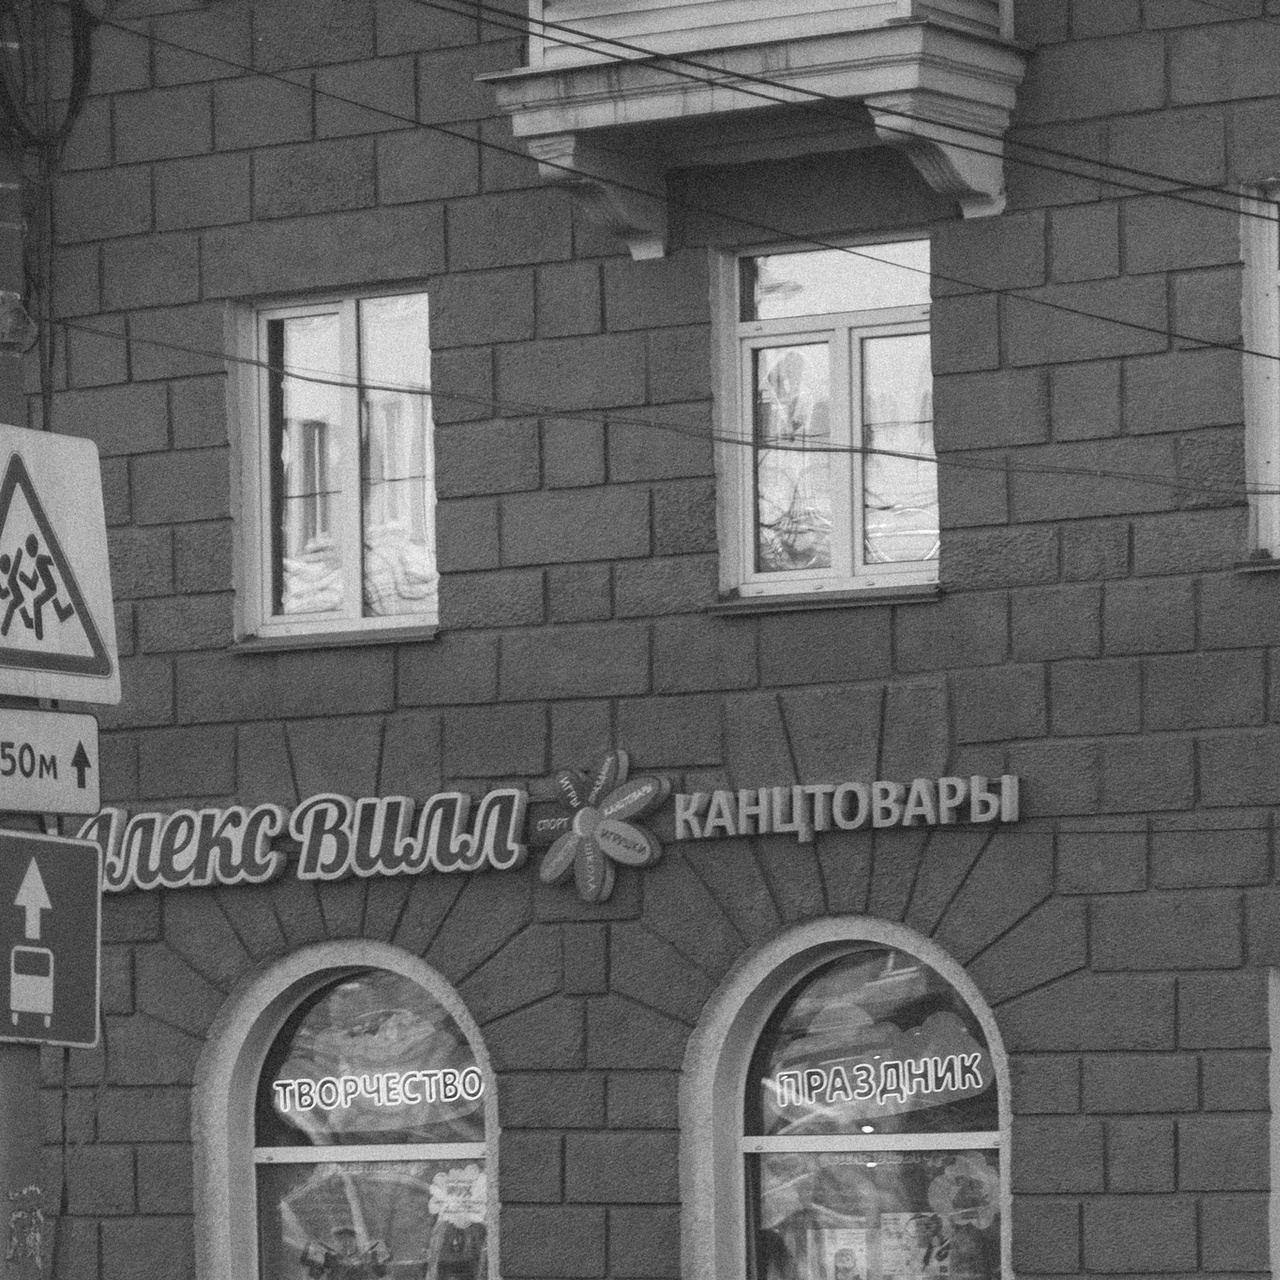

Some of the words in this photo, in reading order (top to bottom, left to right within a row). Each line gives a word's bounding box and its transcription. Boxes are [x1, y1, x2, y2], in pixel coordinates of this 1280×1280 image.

[559, 776, 581, 808] ИГРЫ
[674, 774, 1020, 843] КАНЦТОВАРЫ
[585, 842, 597, 893] ШКОЛА
[273, 1067, 485, 1113] ТВОРЧЕСТВО
[776, 1052, 983, 1108] ПРАЗДНИК
